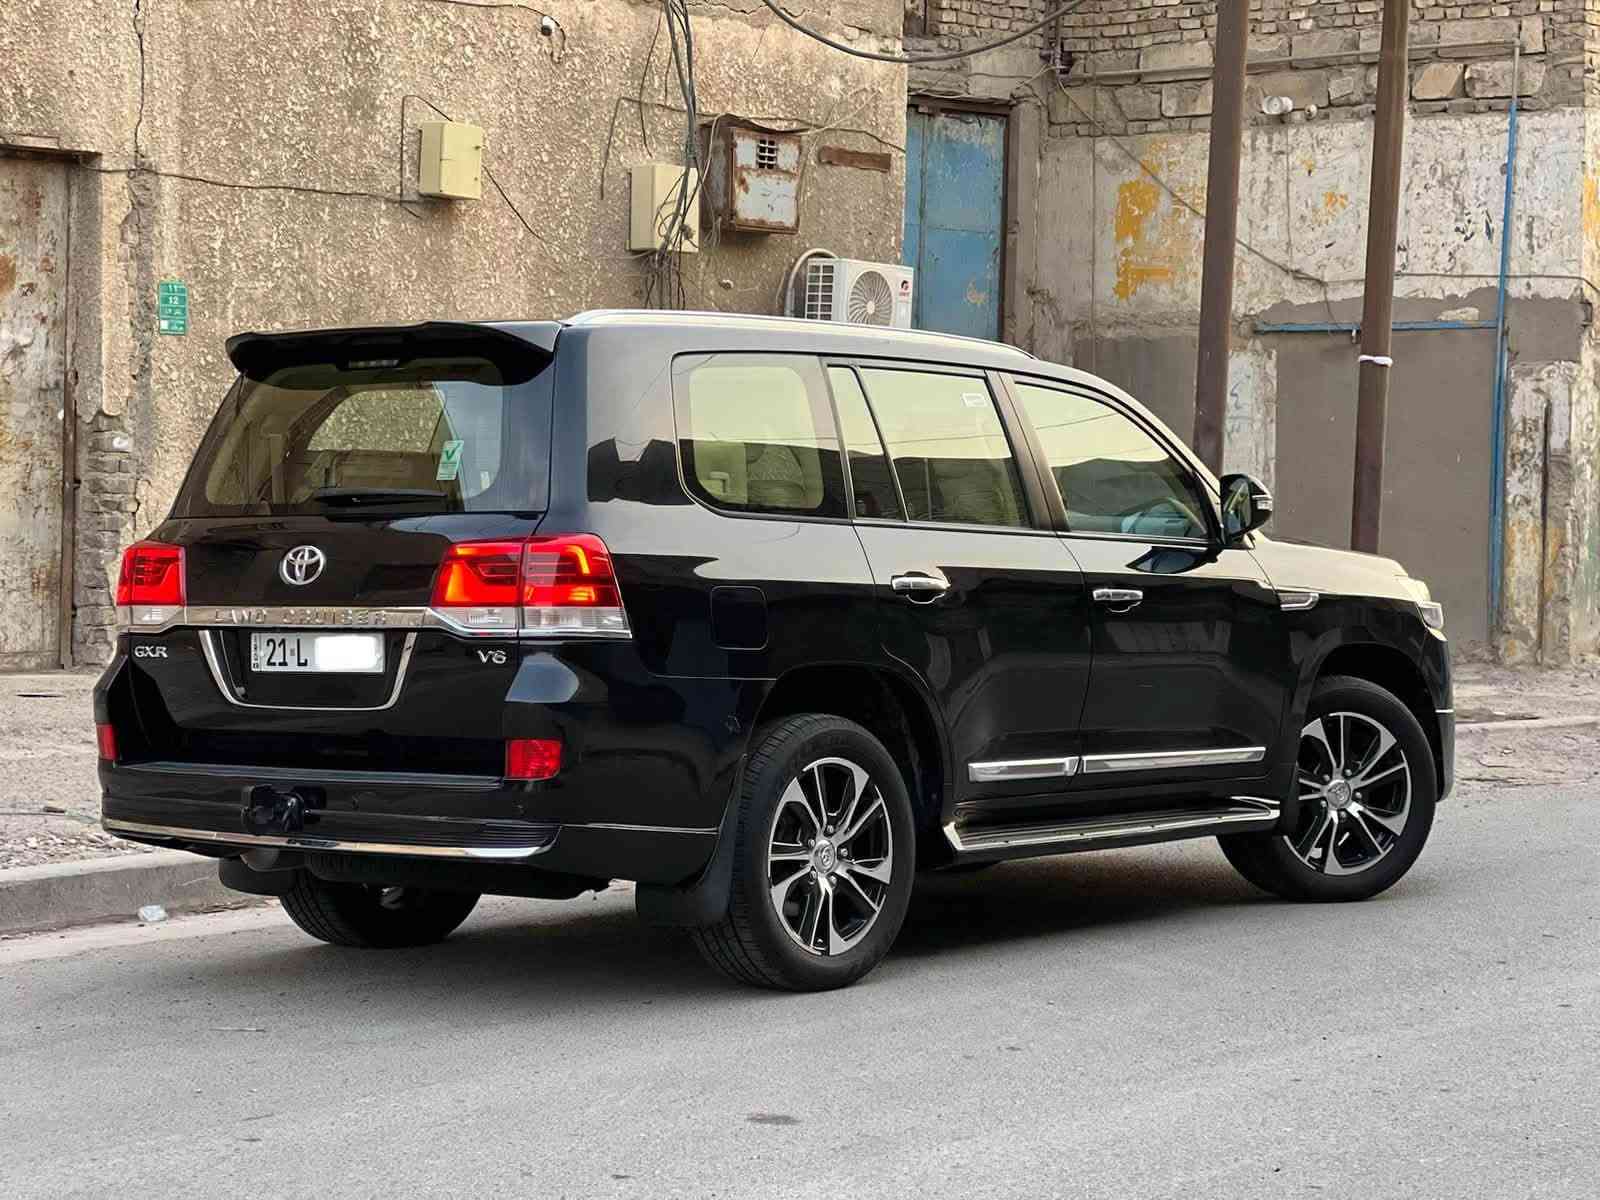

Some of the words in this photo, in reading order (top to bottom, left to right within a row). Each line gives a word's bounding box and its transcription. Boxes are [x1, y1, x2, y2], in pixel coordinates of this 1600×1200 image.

[168, 295, 179, 304] 12
[134, 645, 169, 658] GXR
[266, 637, 288, 667] 21
[296, 637, 308, 667] L
